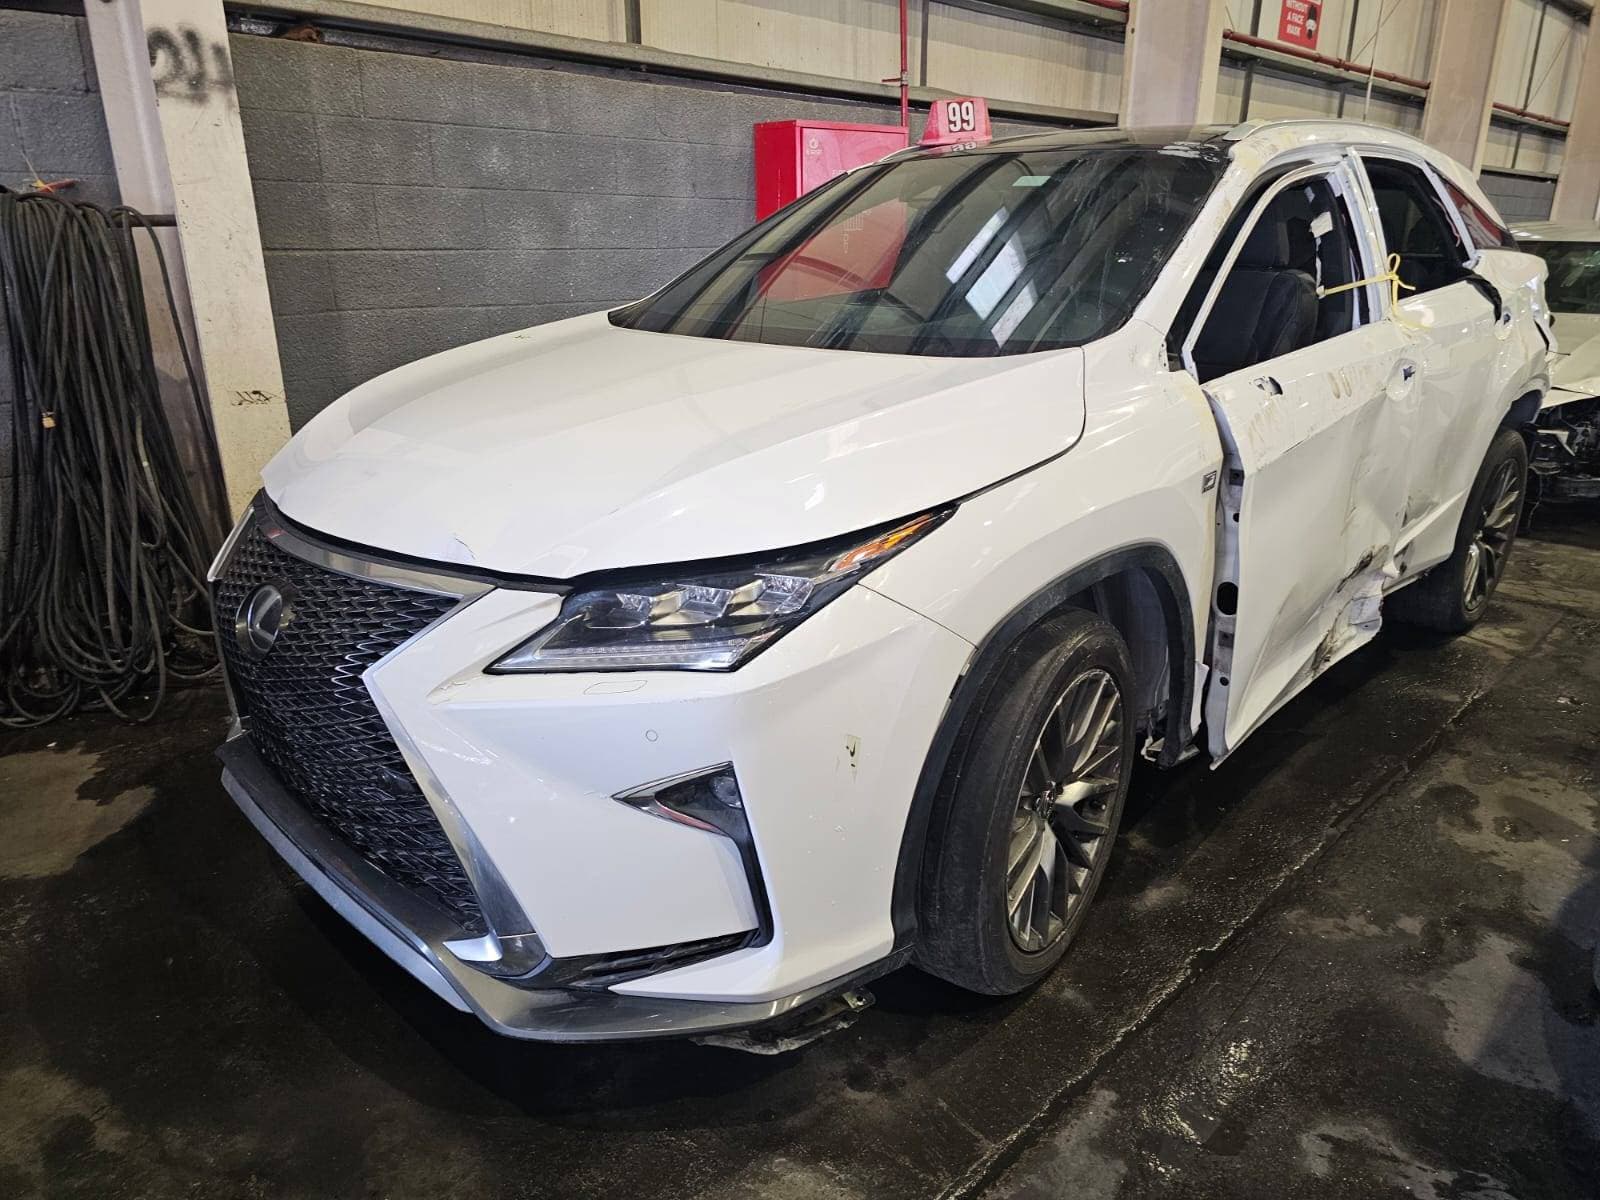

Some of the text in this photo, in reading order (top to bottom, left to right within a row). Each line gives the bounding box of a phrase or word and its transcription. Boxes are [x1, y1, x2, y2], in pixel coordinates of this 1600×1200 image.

[1291, 12, 1305, 25] FACE
[1286, 23, 1302, 37] MASK
[947, 101, 975, 132] 99
